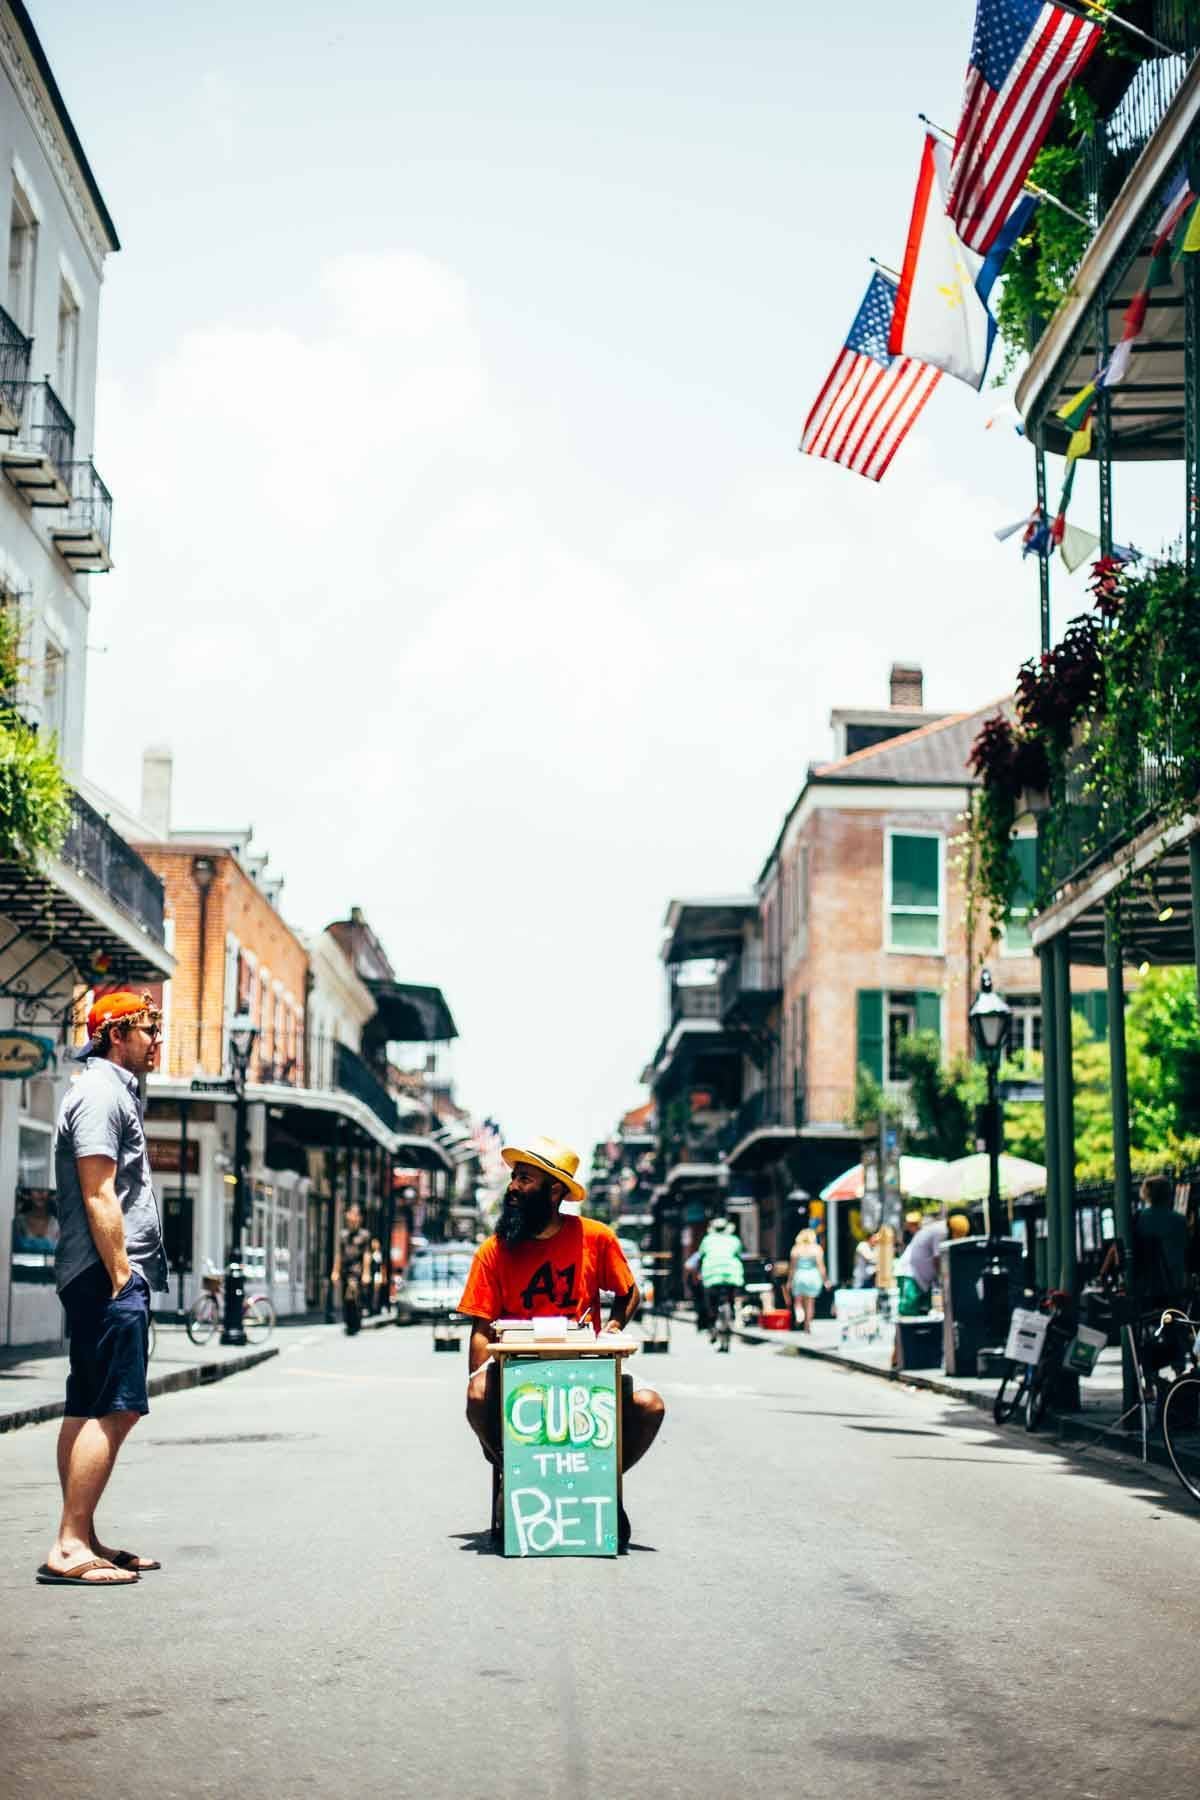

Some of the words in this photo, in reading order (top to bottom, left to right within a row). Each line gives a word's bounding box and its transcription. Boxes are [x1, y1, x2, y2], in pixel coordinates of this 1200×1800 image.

[521, 1261, 577, 1309] A1
[509, 1384, 617, 1448] CUBS
[532, 1452, 590, 1478] THE
[510, 1487, 613, 1557] POET
